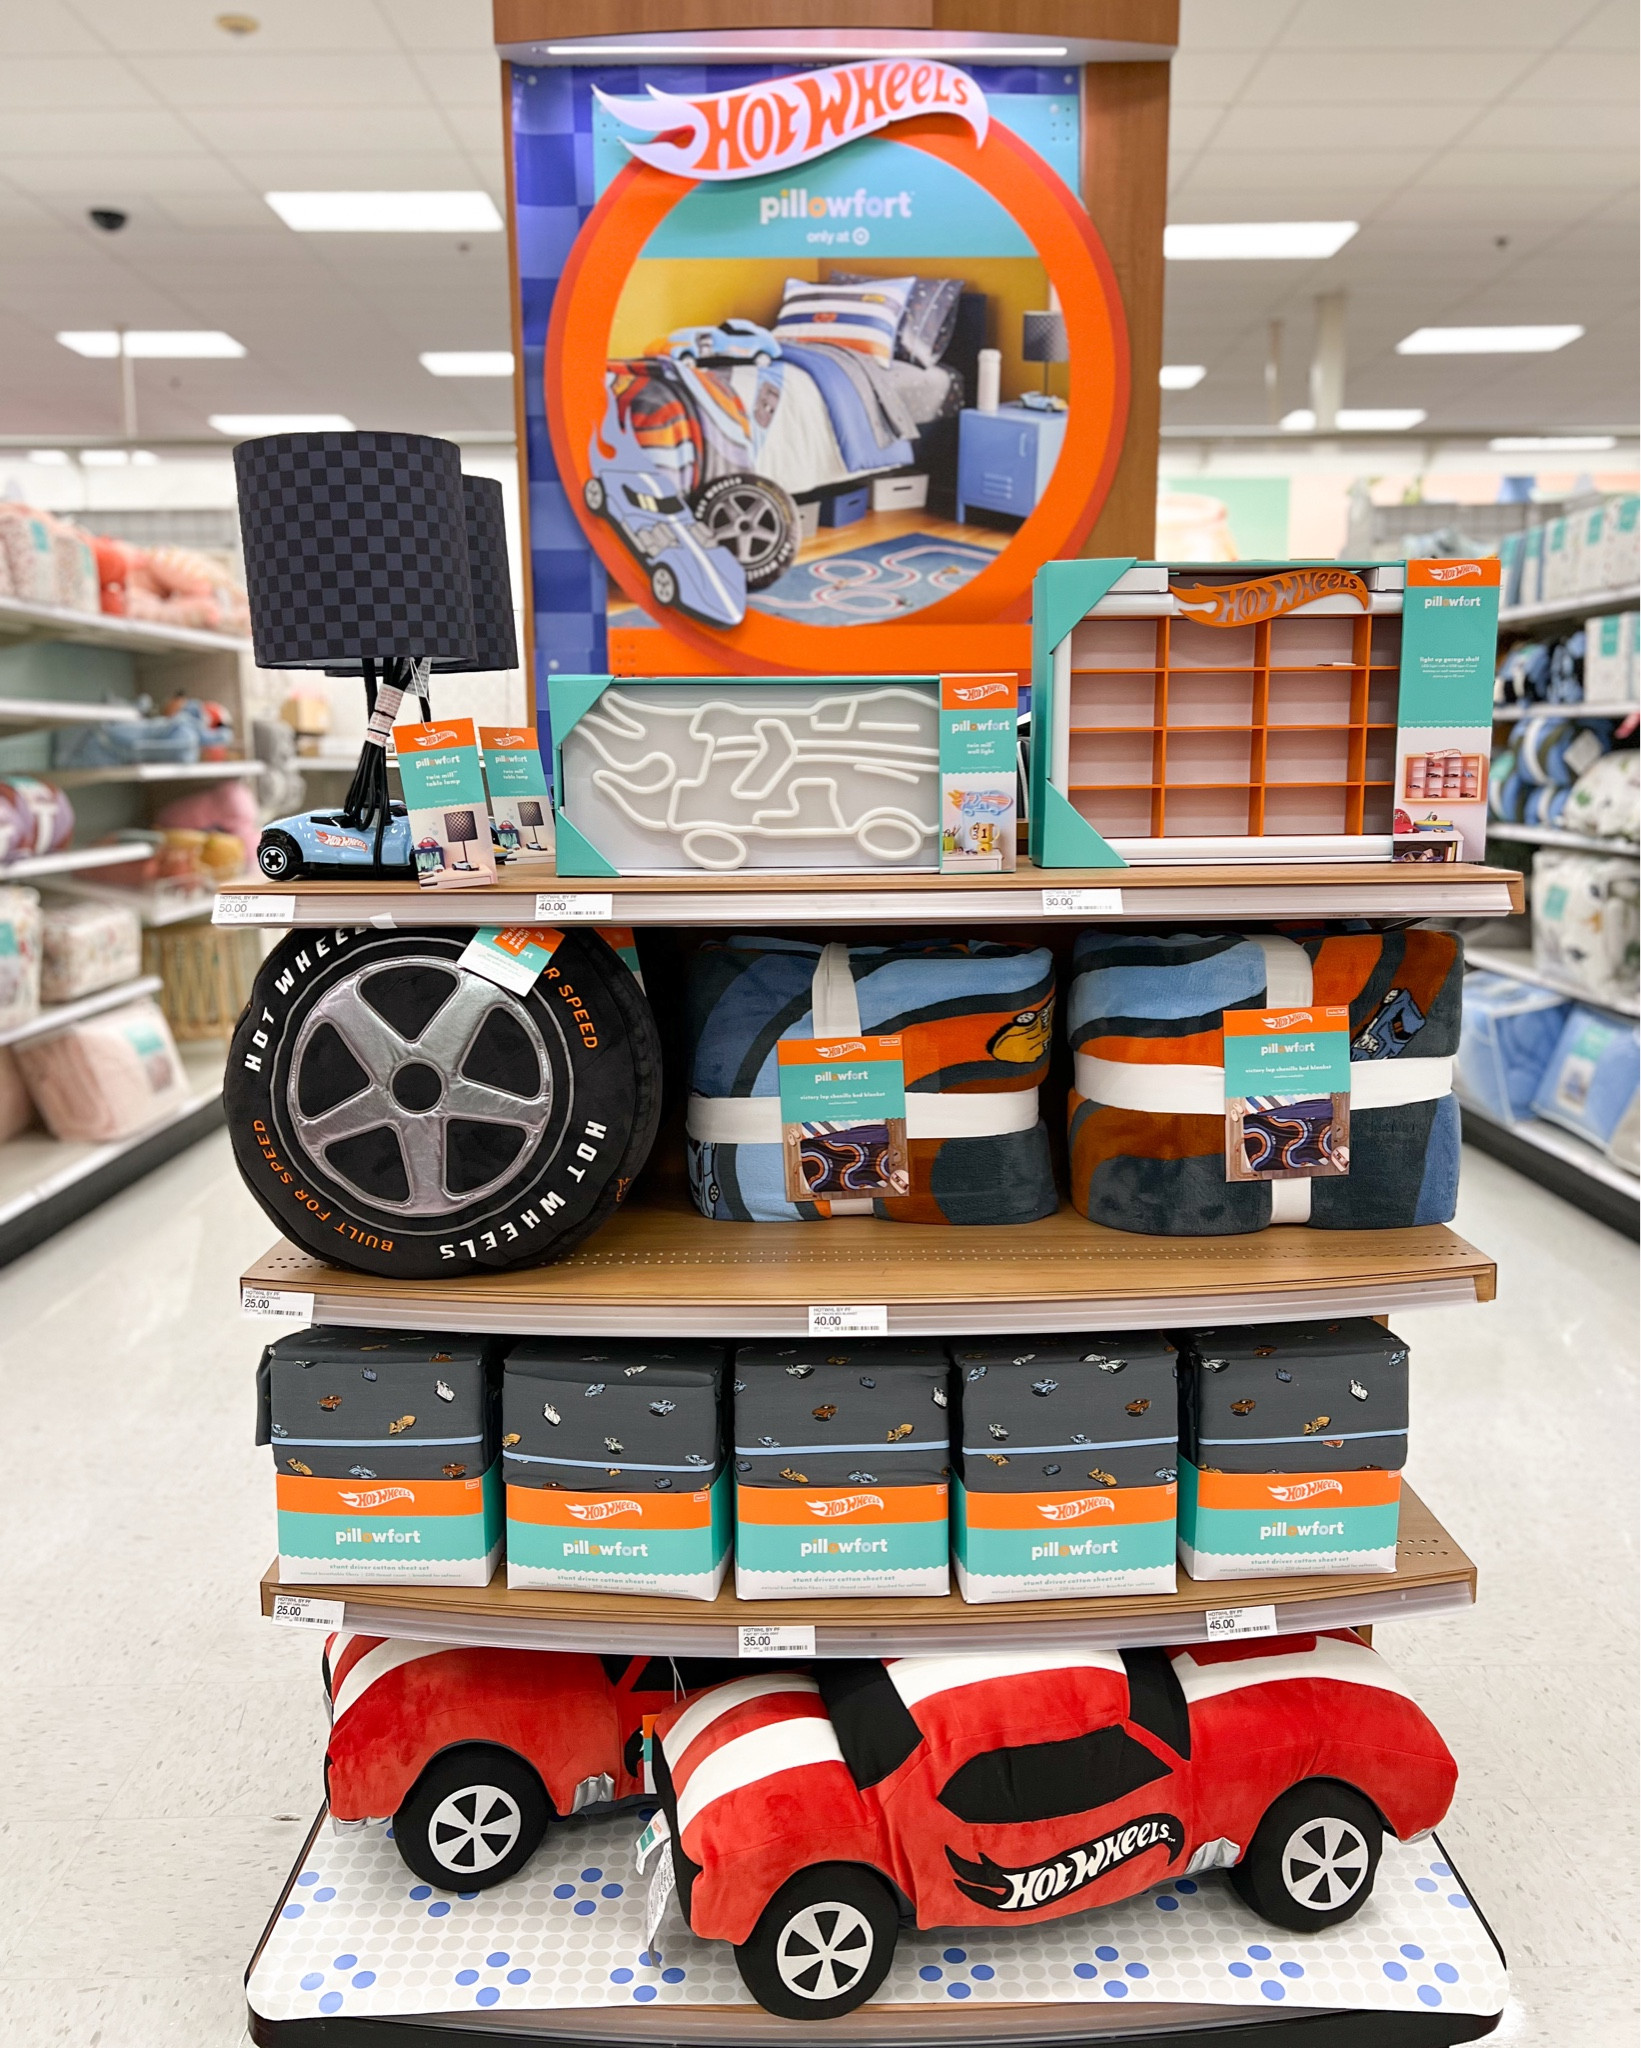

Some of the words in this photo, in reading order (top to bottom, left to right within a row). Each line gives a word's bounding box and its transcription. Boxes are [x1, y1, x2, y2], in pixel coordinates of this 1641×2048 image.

[760, 189, 913, 224] pillowfort
[806, 230, 836, 246] only
[836, 231, 850, 244] at
[1424, 595, 1481, 609] pillowfort
[951, 720, 1010, 734] pillowfort
[415, 755, 460, 769] pillowfort
[218, 903, 247, 913] 50.00
[538, 902, 566, 911] 40.00
[1046, 897, 1073, 906] 30.00
[558, 984, 598, 1050] SPEED
[244, 1007, 275, 1073] HOT
[1261, 1042, 1315, 1056] pillowfort
[815, 1070, 869, 1084] pillowfort
[252, 1119, 295, 1184] SPEED
[566, 1120, 608, 1185] HOT
[293, 1188, 331, 1223] FOR
[438, 1191, 567, 1261] WHEELS
[333, 1220, 395, 1253] BUILT
[245, 1299, 270, 1309] 25.00
[814, 1316, 841, 1326] 40.00
[335, 1528, 421, 1545] pillowfort
[1260, 1521, 1344, 1540] pillowfort
[563, 1540, 648, 1557] pillowfort
[801, 1538, 888, 1557] pillowfort
[1031, 1540, 1118, 1560] pillowfort
[277, 1605, 302, 1616] 25.00
[1209, 1619, 1235, 1629] 45.00
[743, 1636, 771, 1646] 35.00
